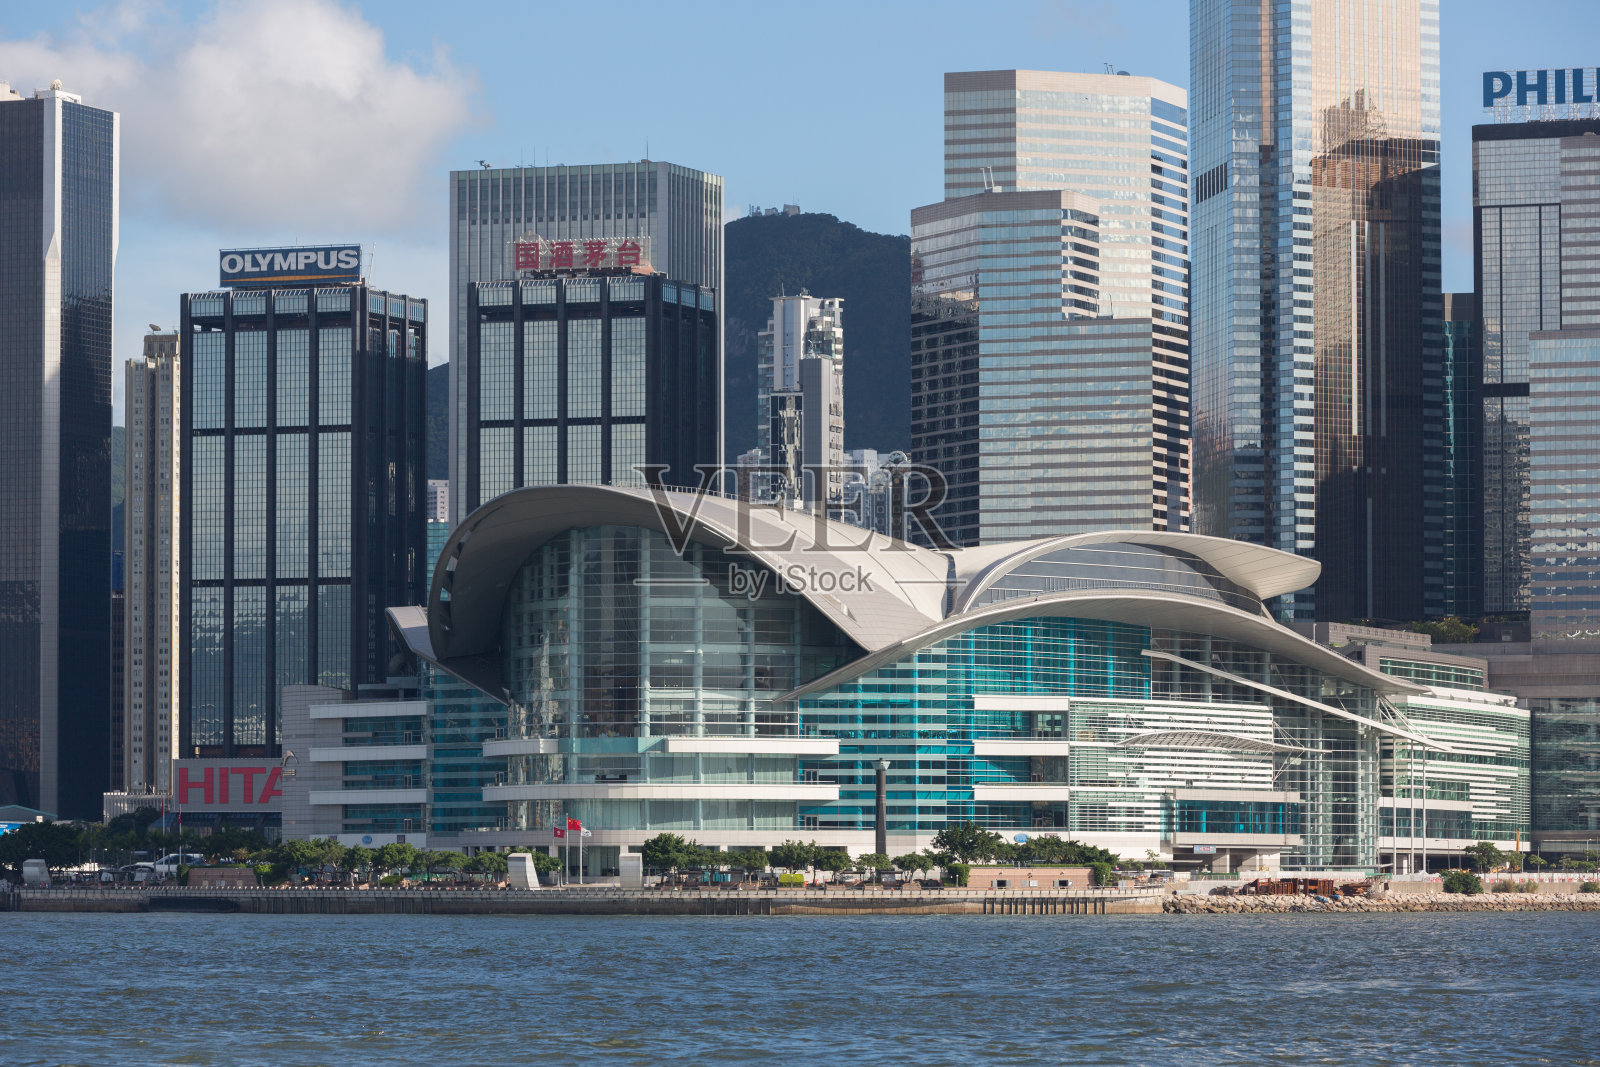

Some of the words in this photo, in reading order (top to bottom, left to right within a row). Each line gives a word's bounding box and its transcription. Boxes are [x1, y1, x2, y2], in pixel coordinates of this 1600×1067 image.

[221, 250, 358, 273] OLYMPUS
[515, 239, 641, 270] 国酒茅台
